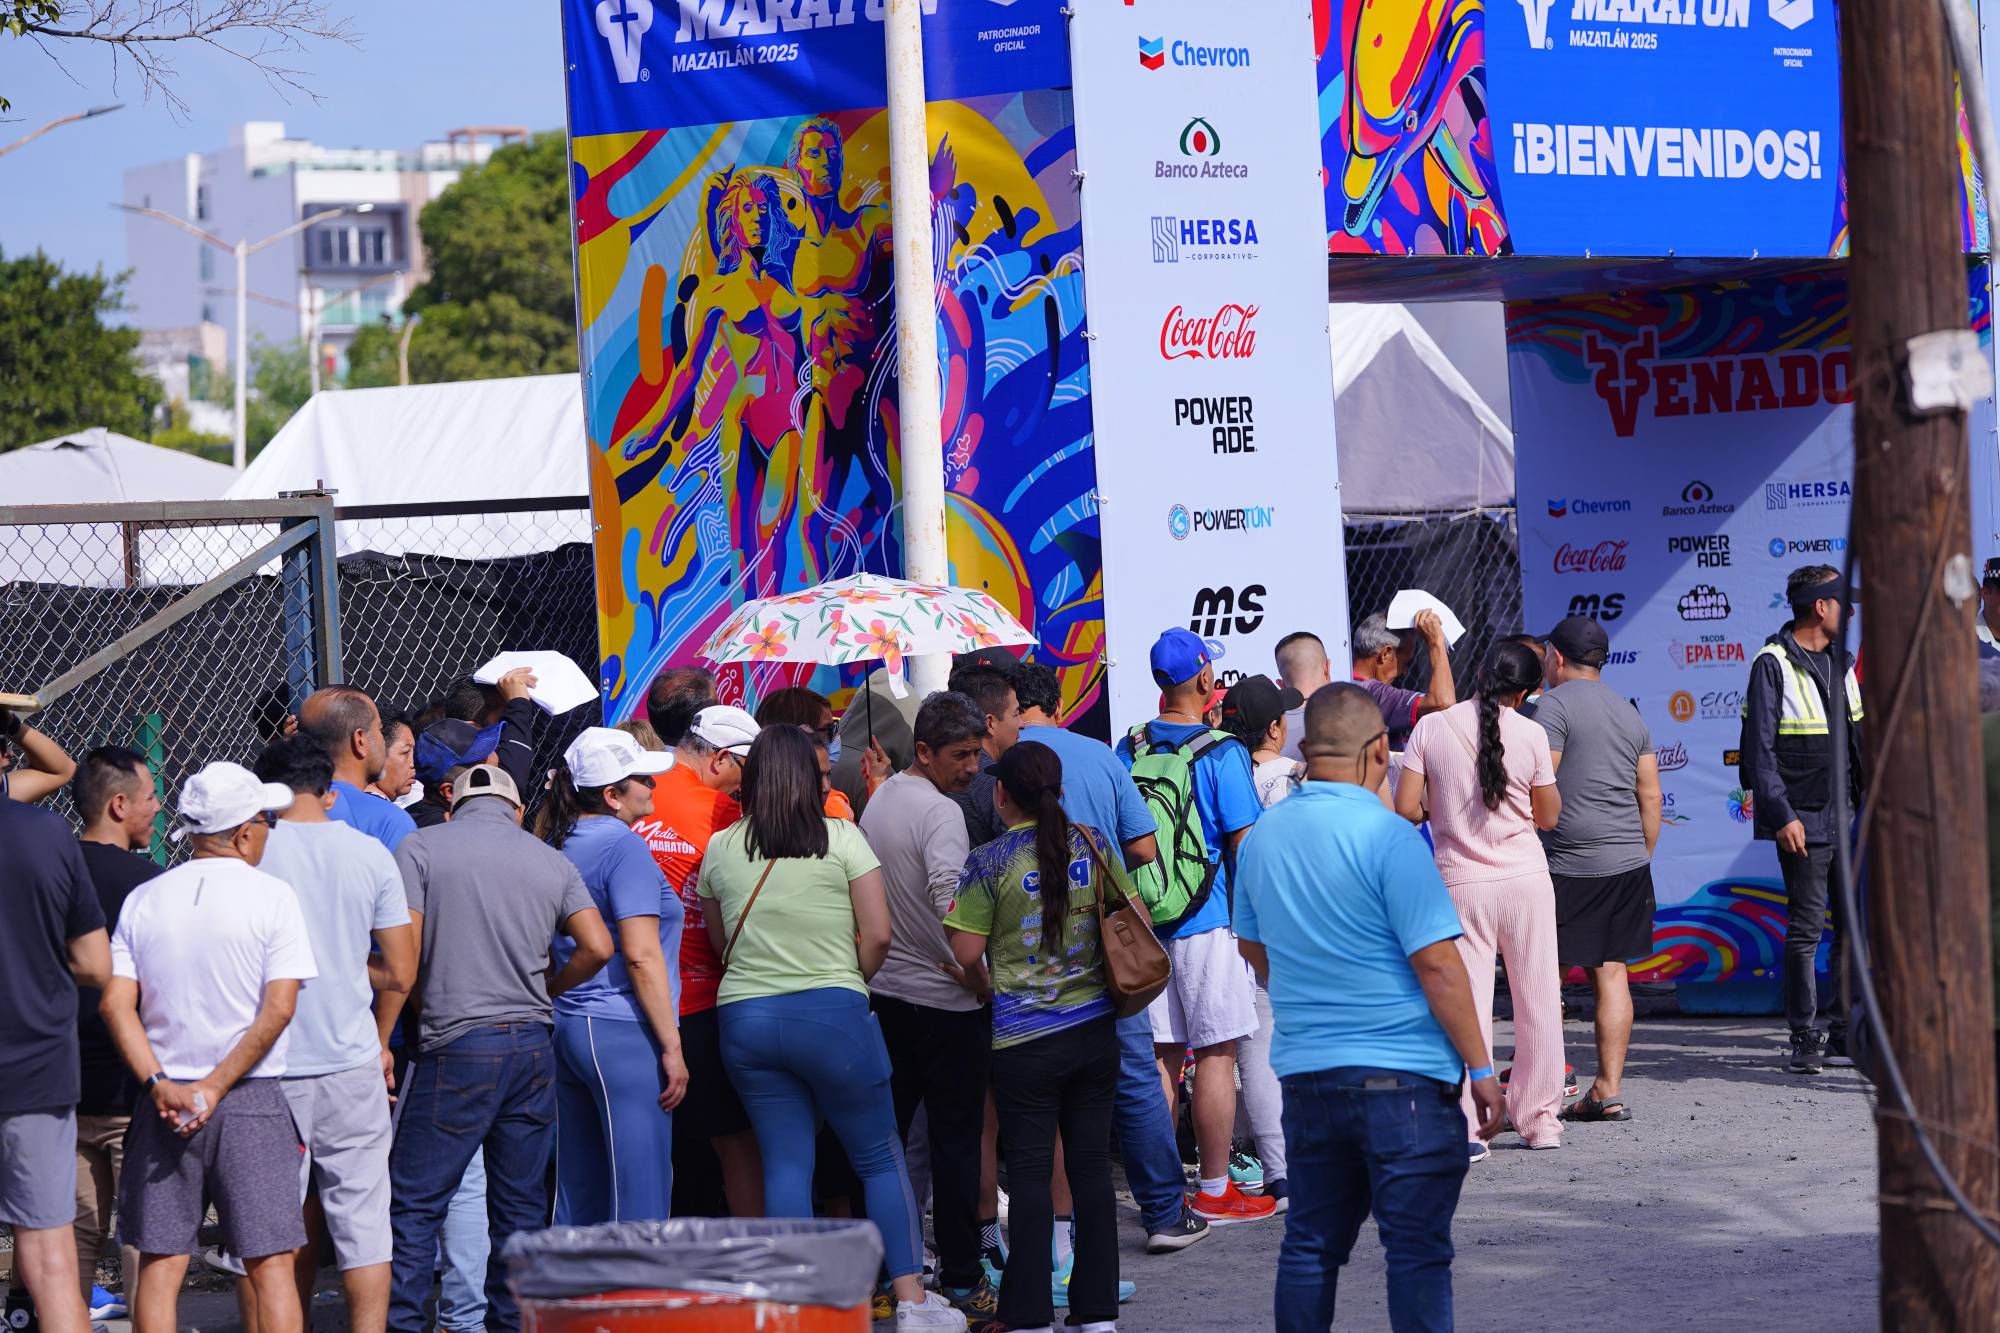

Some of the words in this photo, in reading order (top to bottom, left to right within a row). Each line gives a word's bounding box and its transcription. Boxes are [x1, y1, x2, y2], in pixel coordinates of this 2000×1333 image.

[978, 24, 1041, 41] PATROCINADOR
[1569, 28, 1629, 48] MAZATLÁN
[1631, 33, 1658, 50] 2025
[994, 40, 1026, 52] OFICIAL
[1171, 40, 1250, 67] Chevron
[1773, 47, 1813, 58] PATROCINADOR
[672, 44, 754, 72] MAZATLÁN
[757, 43, 799, 65] 2025
[1783, 58, 1804, 68] OFICIAL
[1512, 122, 1822, 180] ¡BIENVENIDOS!
[1155, 160, 1198, 178] Banco
[1200, 160, 1248, 178] Azteca
[1180, 219, 1259, 245] HERSA
[1160, 303, 1260, 360] Coca-Cola
[1175, 396, 1254, 426] POWER
[1212, 426, 1256, 454] ADE
[1788, 480, 1851, 498] HERSA
[1571, 499, 1631, 515] Chevron
[1662, 505, 1695, 517] Banco
[1697, 503, 1735, 515] Azteca
[1668, 535, 1730, 553] POWER
[1553, 539, 1630, 574] Coca-Cola
[1697, 551, 1732, 568] ADE
[1700, 635, 1725, 643] TACOS
